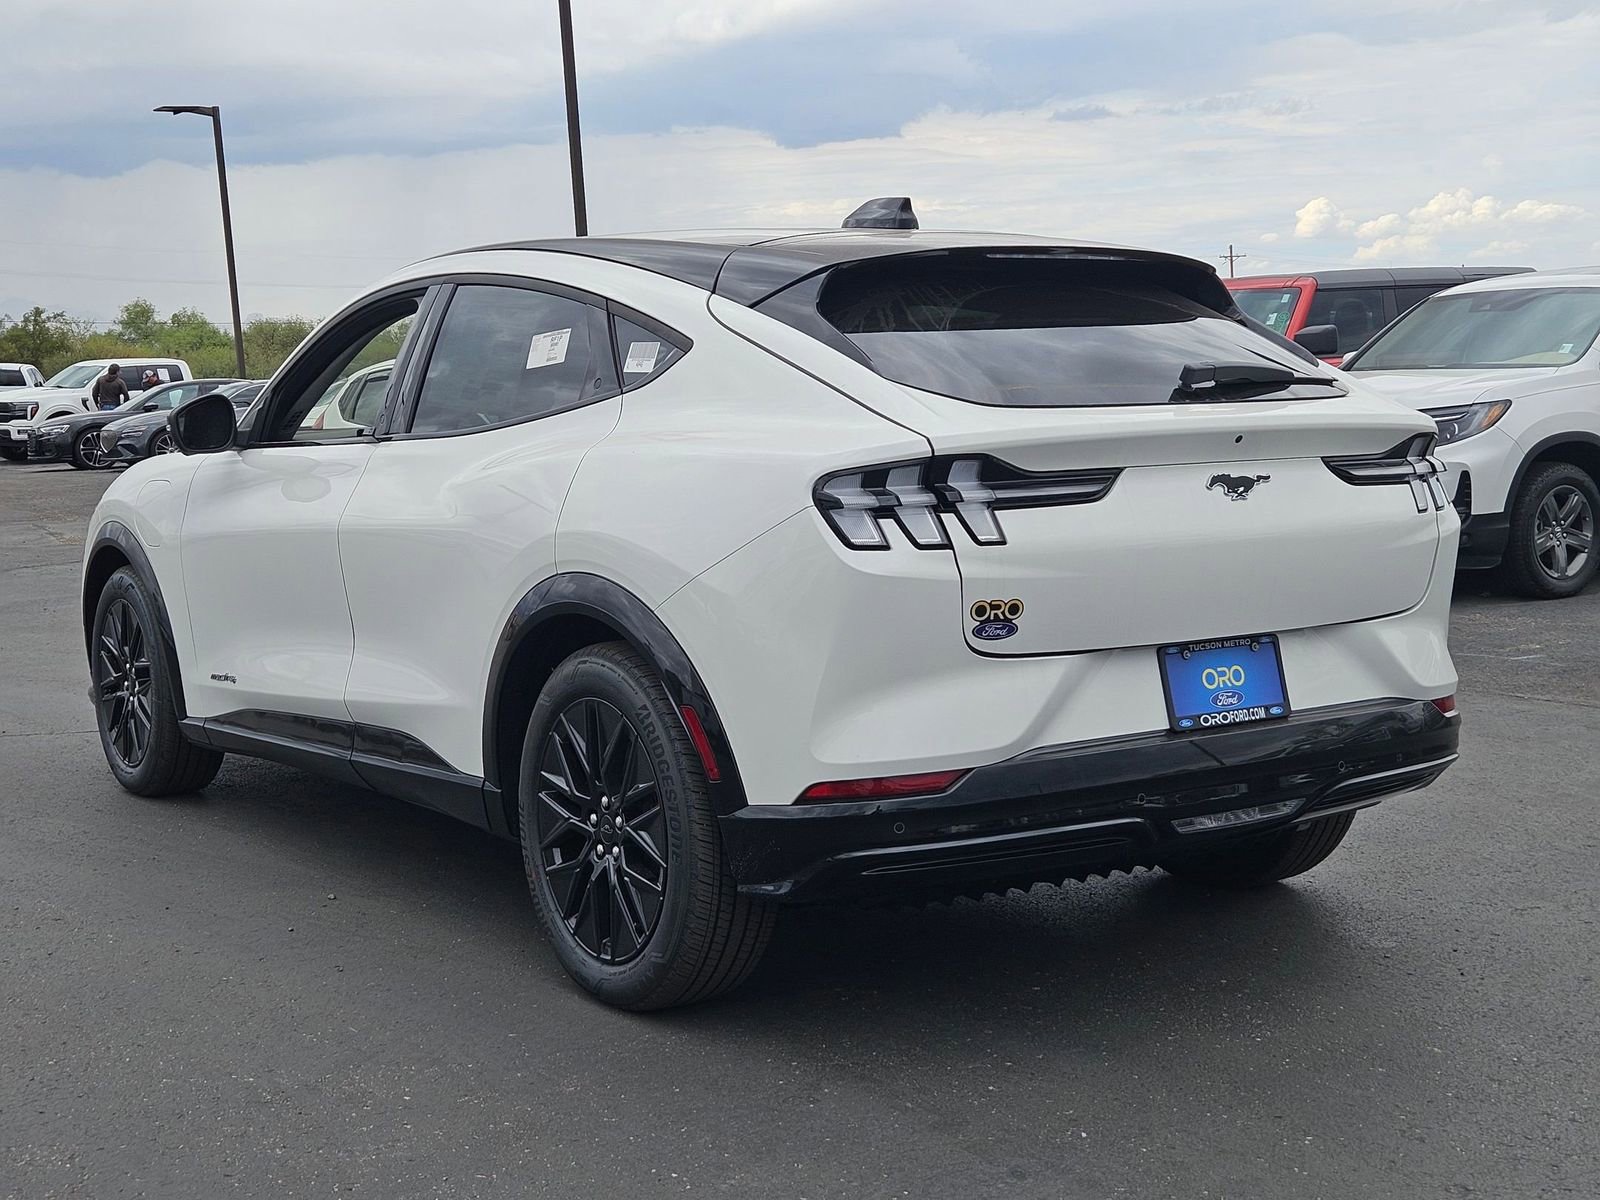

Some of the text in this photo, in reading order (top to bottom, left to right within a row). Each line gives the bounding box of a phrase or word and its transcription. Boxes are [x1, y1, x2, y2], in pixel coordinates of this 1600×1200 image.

[970, 599, 1024, 621] ORO
[982, 624, 1009, 636] Ford
[1188, 641, 1222, 652] TUCSON
[1223, 638, 1251, 647] METRO
[1202, 665, 1245, 689] ORO
[1216, 692, 1238, 706] Ford
[1200, 707, 1266, 726] OROFORD.COM
[635, 704, 682, 864] BRIDGESTONE
